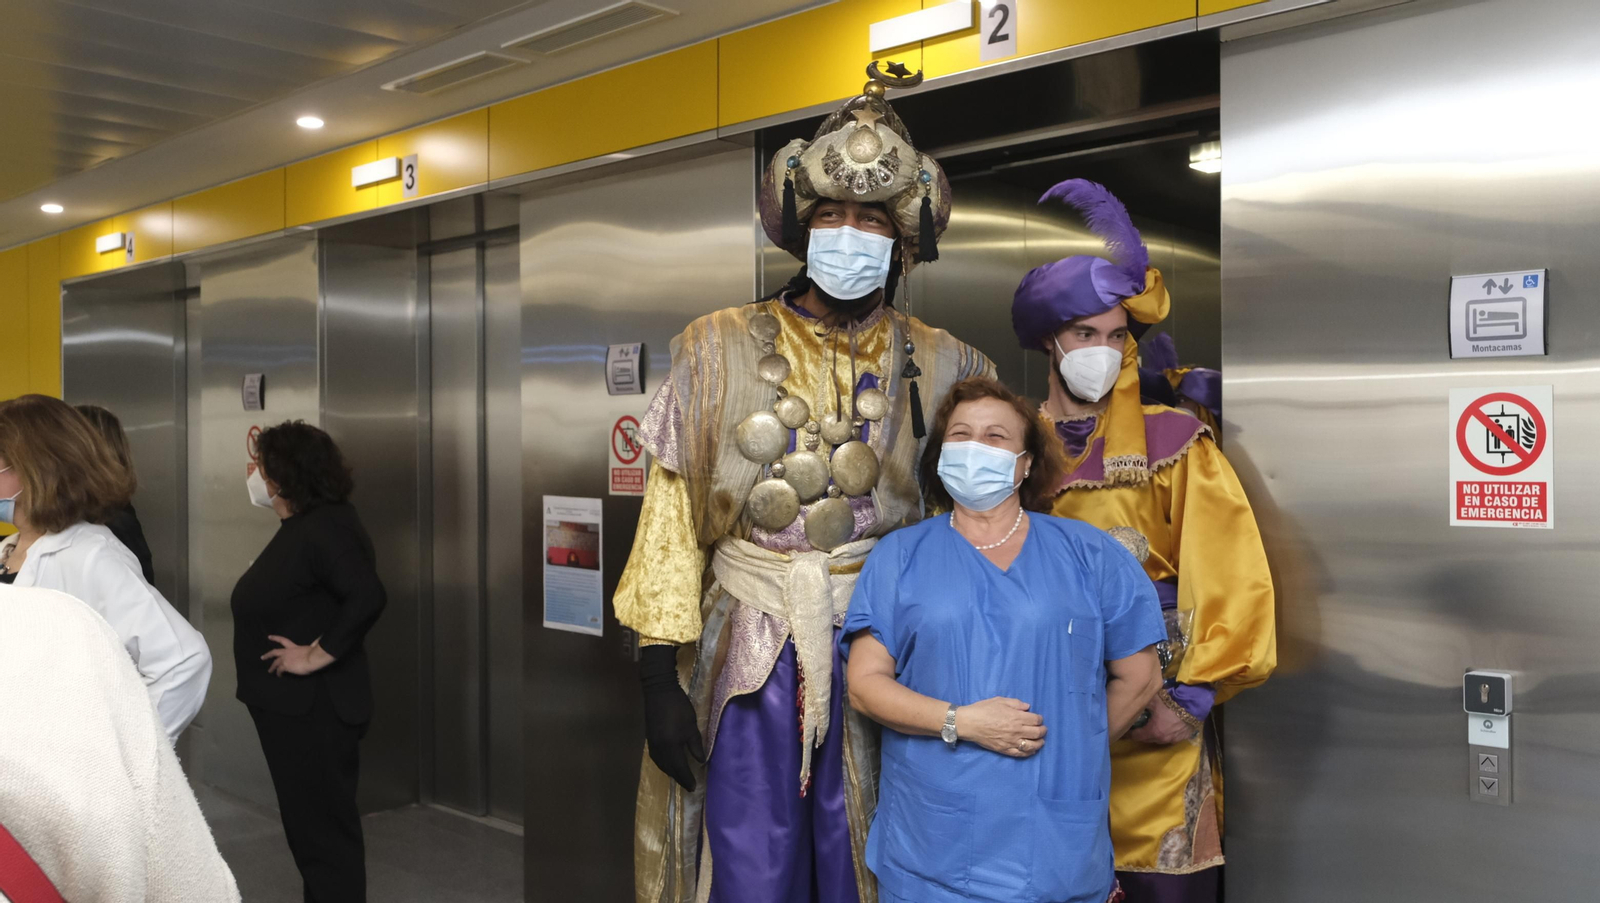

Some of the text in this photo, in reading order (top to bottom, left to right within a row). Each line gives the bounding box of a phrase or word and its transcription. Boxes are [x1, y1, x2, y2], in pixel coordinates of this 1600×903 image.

[987, 3, 1009, 45] 2
[405, 163, 415, 190] 3
[127, 237, 133, 257] 4
[1472, 344, 1522, 353] Montacamas
[1463, 484, 1540, 495] NO UTILIZAR
[1465, 496, 1538, 507] EN CASO DE
[1461, 508, 1543, 519] EMERGENCIA
